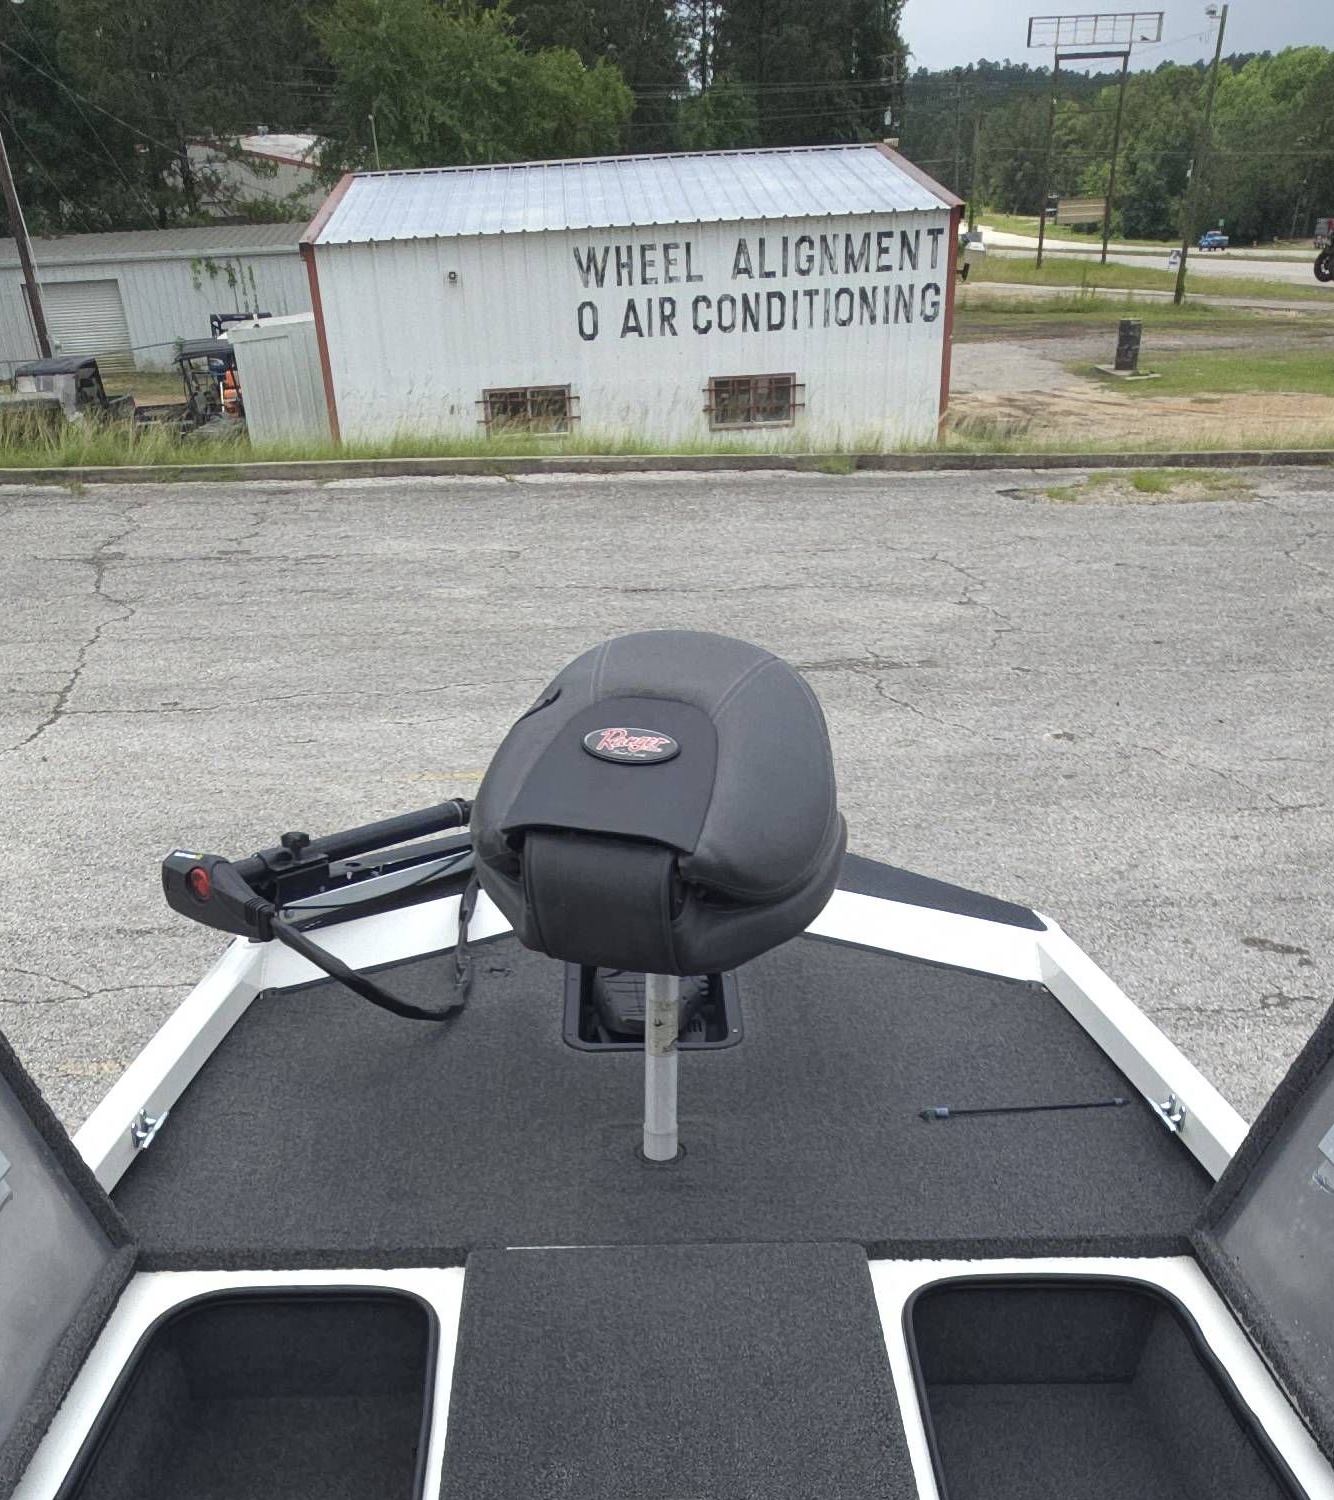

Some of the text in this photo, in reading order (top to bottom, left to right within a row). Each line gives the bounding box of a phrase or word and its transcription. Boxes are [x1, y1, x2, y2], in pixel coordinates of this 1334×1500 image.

[572, 227, 945, 289] WHEEL ALIGNMENT
[620, 295, 679, 339] AIR
[691, 282, 941, 335] CONDITIONING
[596, 728, 671, 752] Ranger
